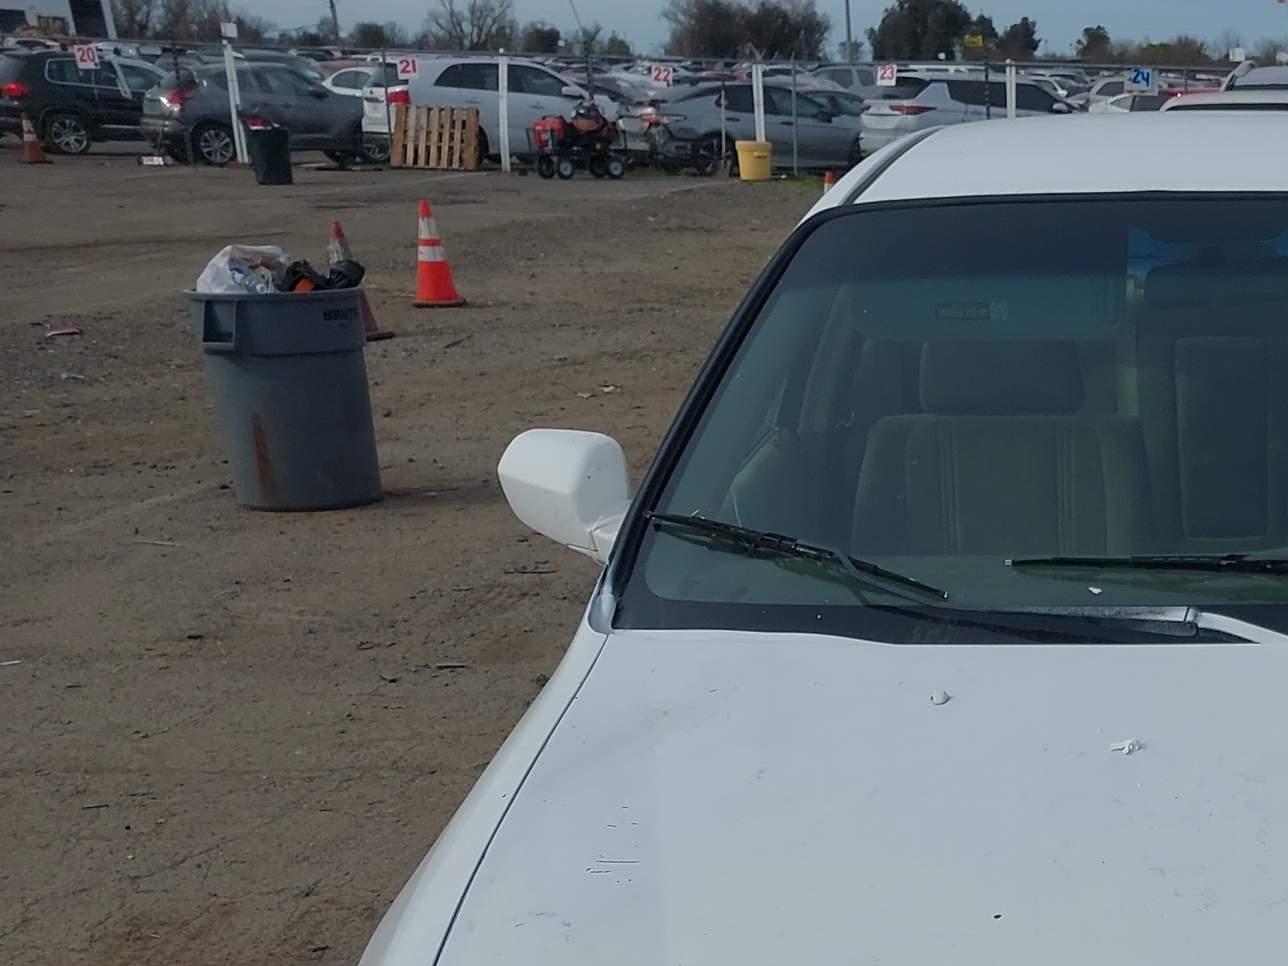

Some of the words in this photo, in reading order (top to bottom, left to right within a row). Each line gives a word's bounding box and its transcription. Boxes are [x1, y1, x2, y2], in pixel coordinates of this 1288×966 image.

[76, 47, 96, 62] 20
[399, 59, 417, 73] 21
[880, 66, 895, 80] 23
[654, 67, 670, 82] 22
[1132, 68, 1150, 87] 24
